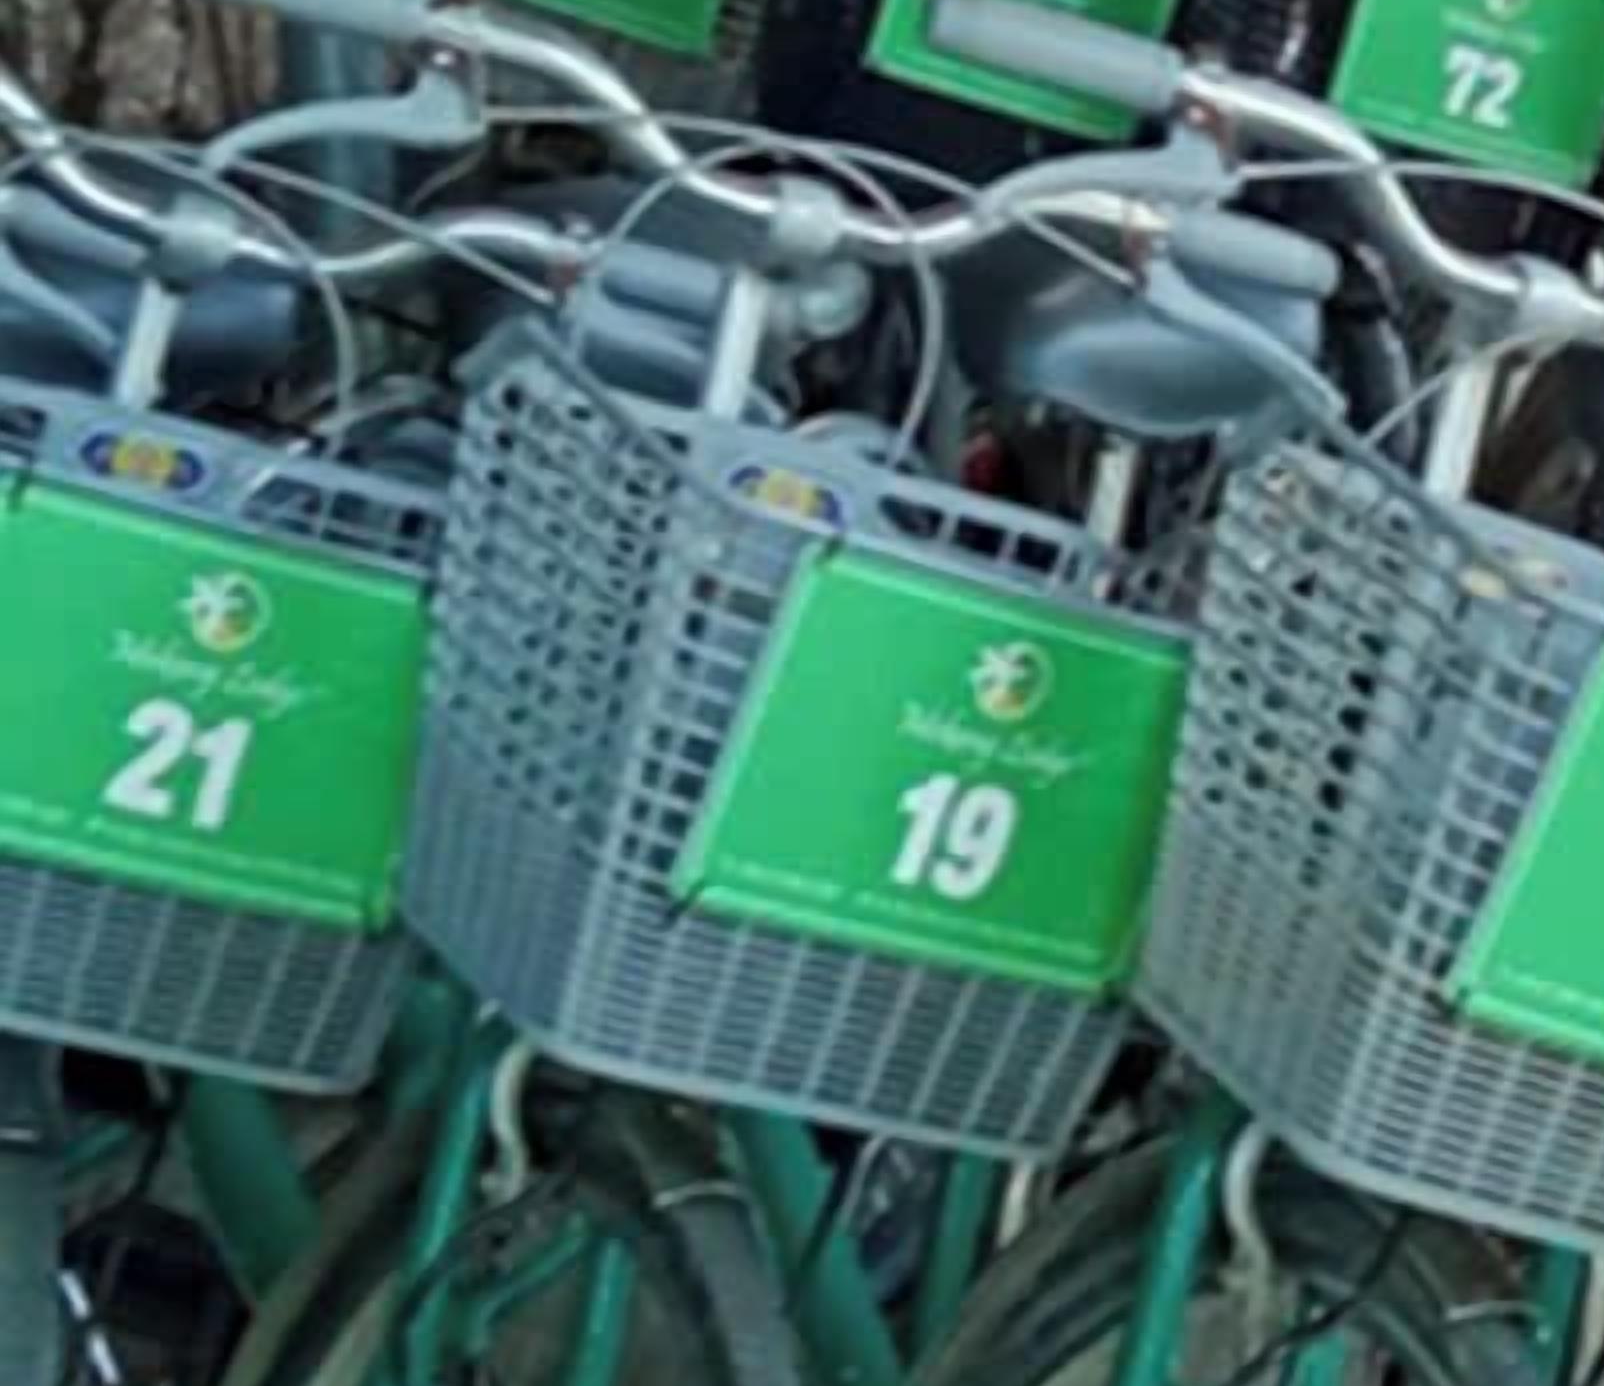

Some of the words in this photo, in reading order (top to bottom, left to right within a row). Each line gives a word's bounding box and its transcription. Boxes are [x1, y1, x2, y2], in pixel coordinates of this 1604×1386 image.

[1444, 45, 1523, 129] 72
[103, 696, 253, 832] 21
[890, 770, 1017, 902] 19
